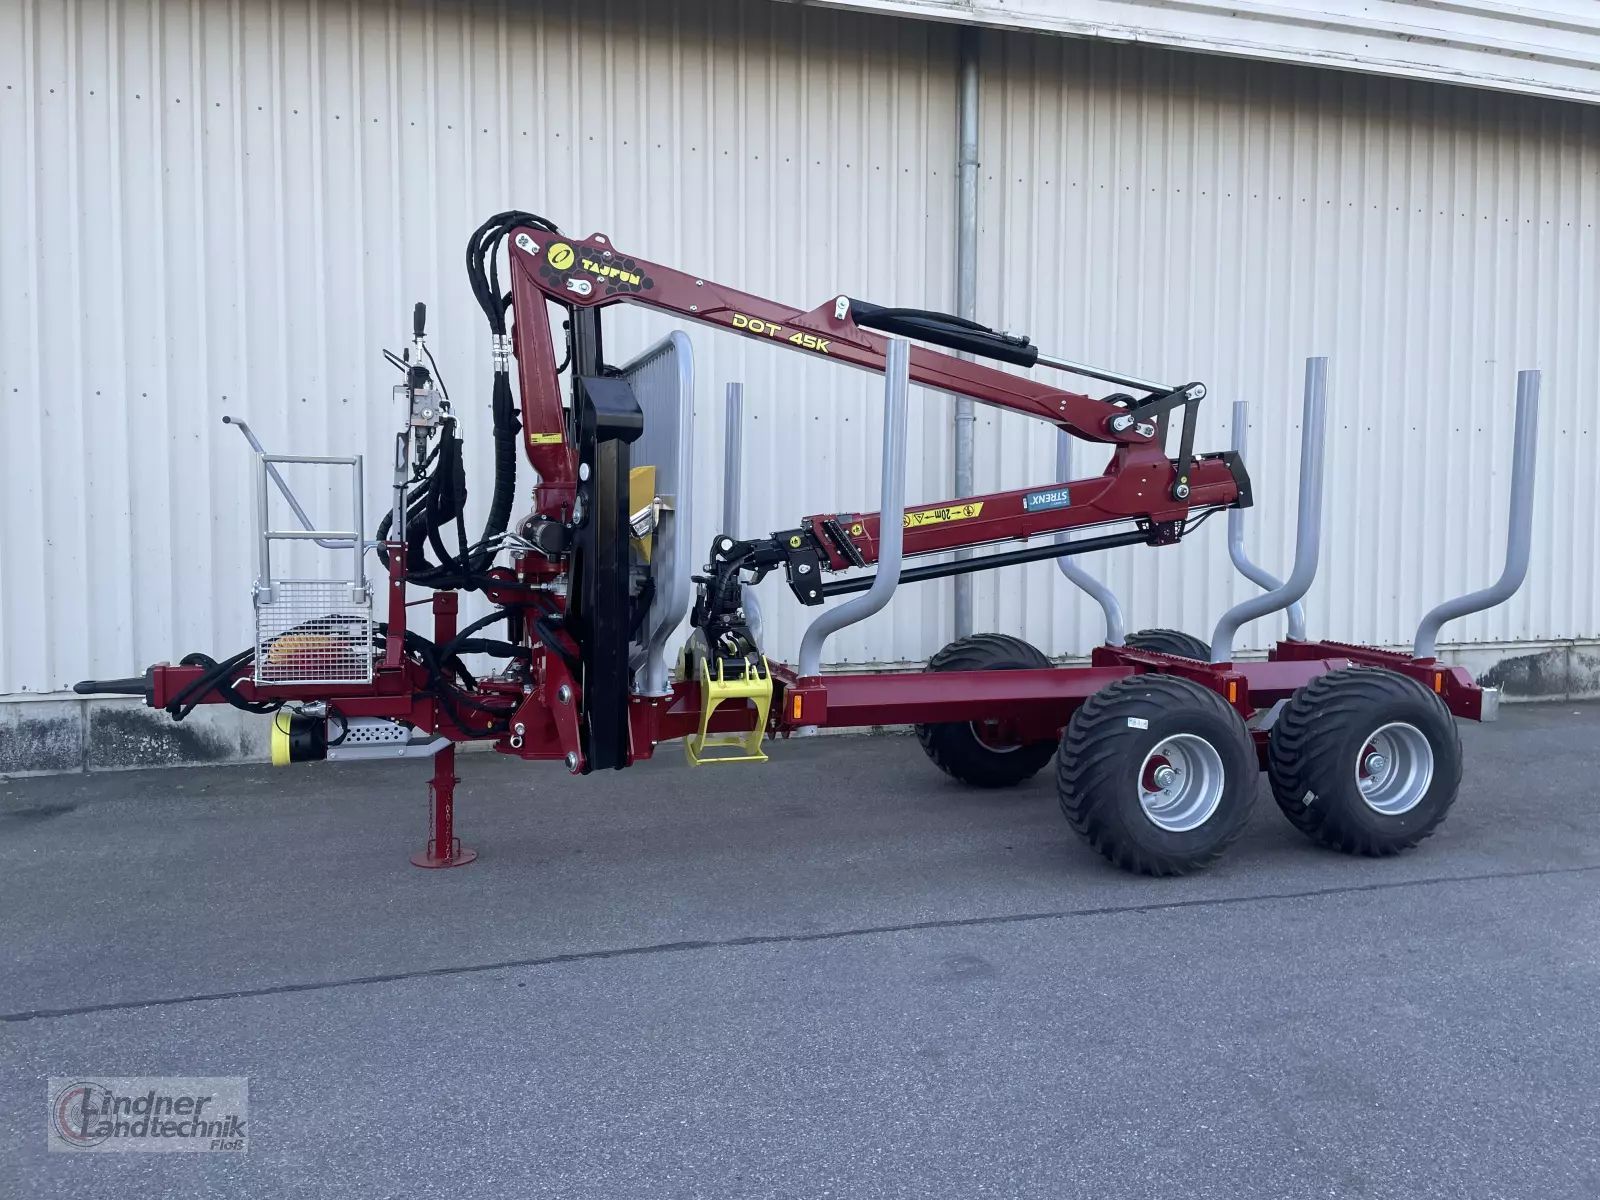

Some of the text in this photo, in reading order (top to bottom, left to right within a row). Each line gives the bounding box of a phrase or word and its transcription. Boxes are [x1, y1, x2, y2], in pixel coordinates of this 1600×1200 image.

[582, 259, 640, 285] TAJFUN
[732, 313, 830, 354] DOT 45K
[1032, 491, 1067, 505] STRENX
[934, 509, 951, 521] 20m
